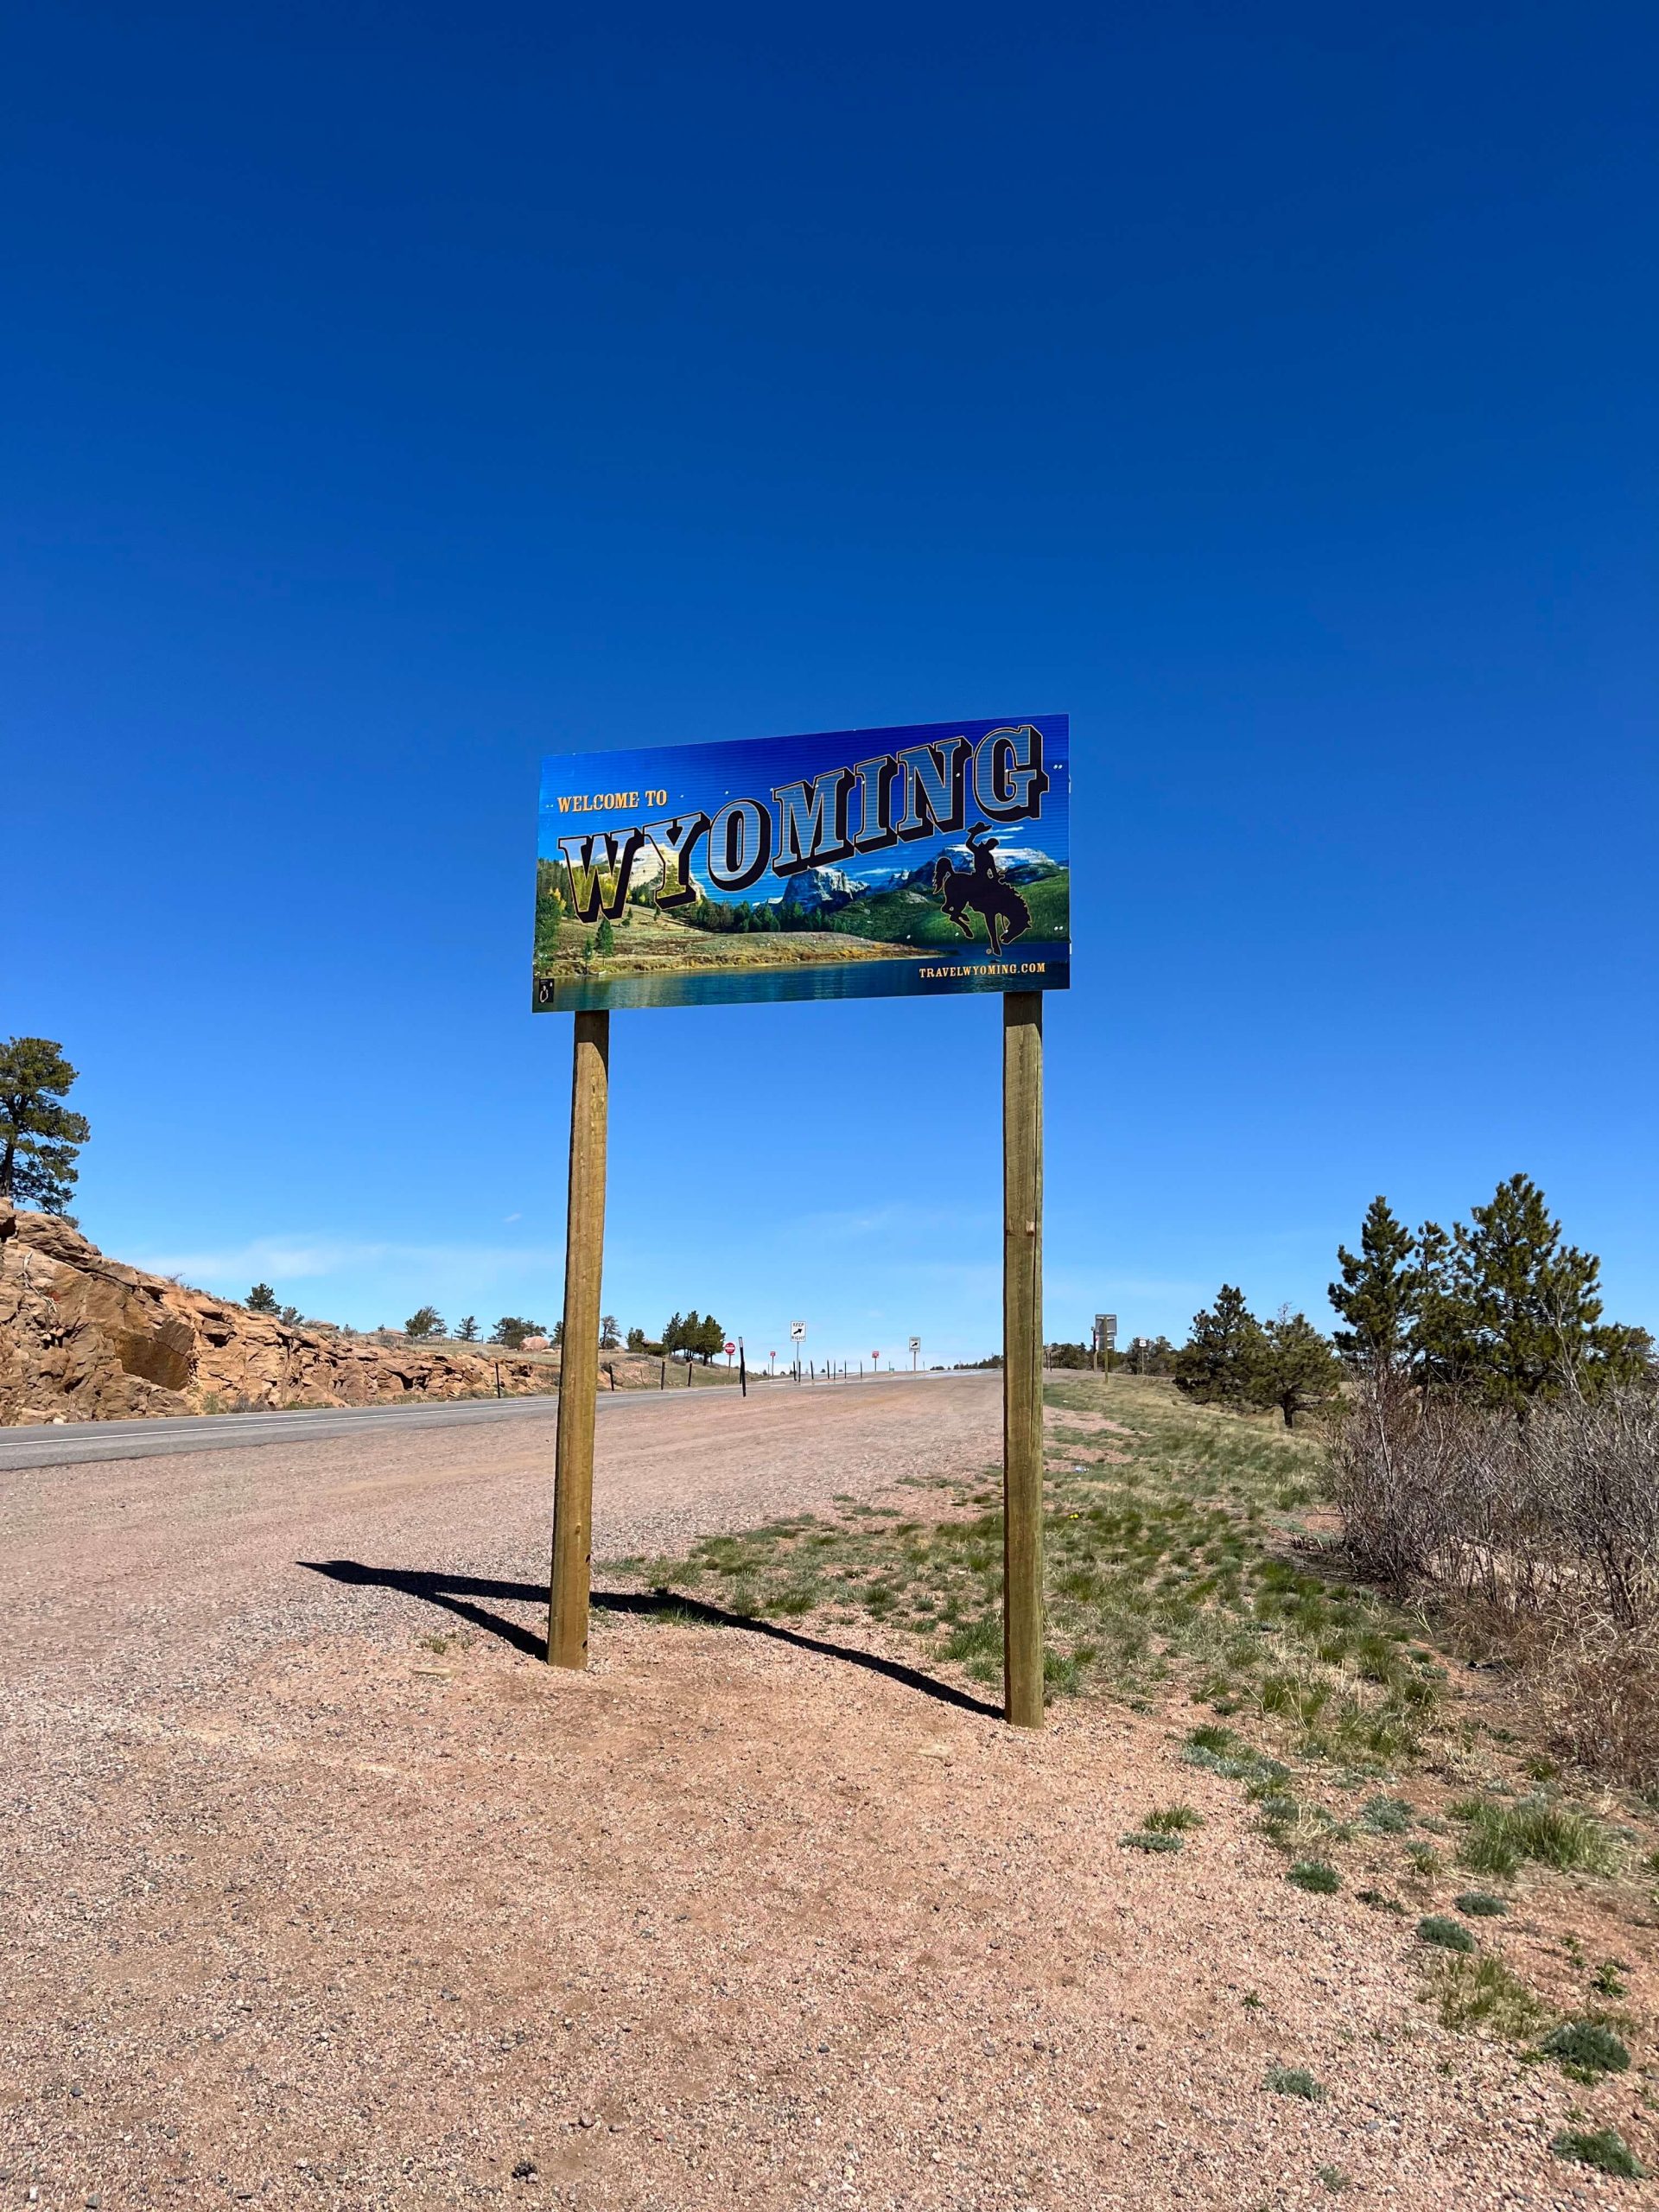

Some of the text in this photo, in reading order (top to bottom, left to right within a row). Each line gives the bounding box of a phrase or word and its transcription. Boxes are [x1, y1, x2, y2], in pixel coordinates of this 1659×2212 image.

[556, 789, 668, 813] WELCOME TO
[558, 724, 1050, 924] WYOMING
[918, 962, 1046, 979] TRAVELWYOMING.COM
